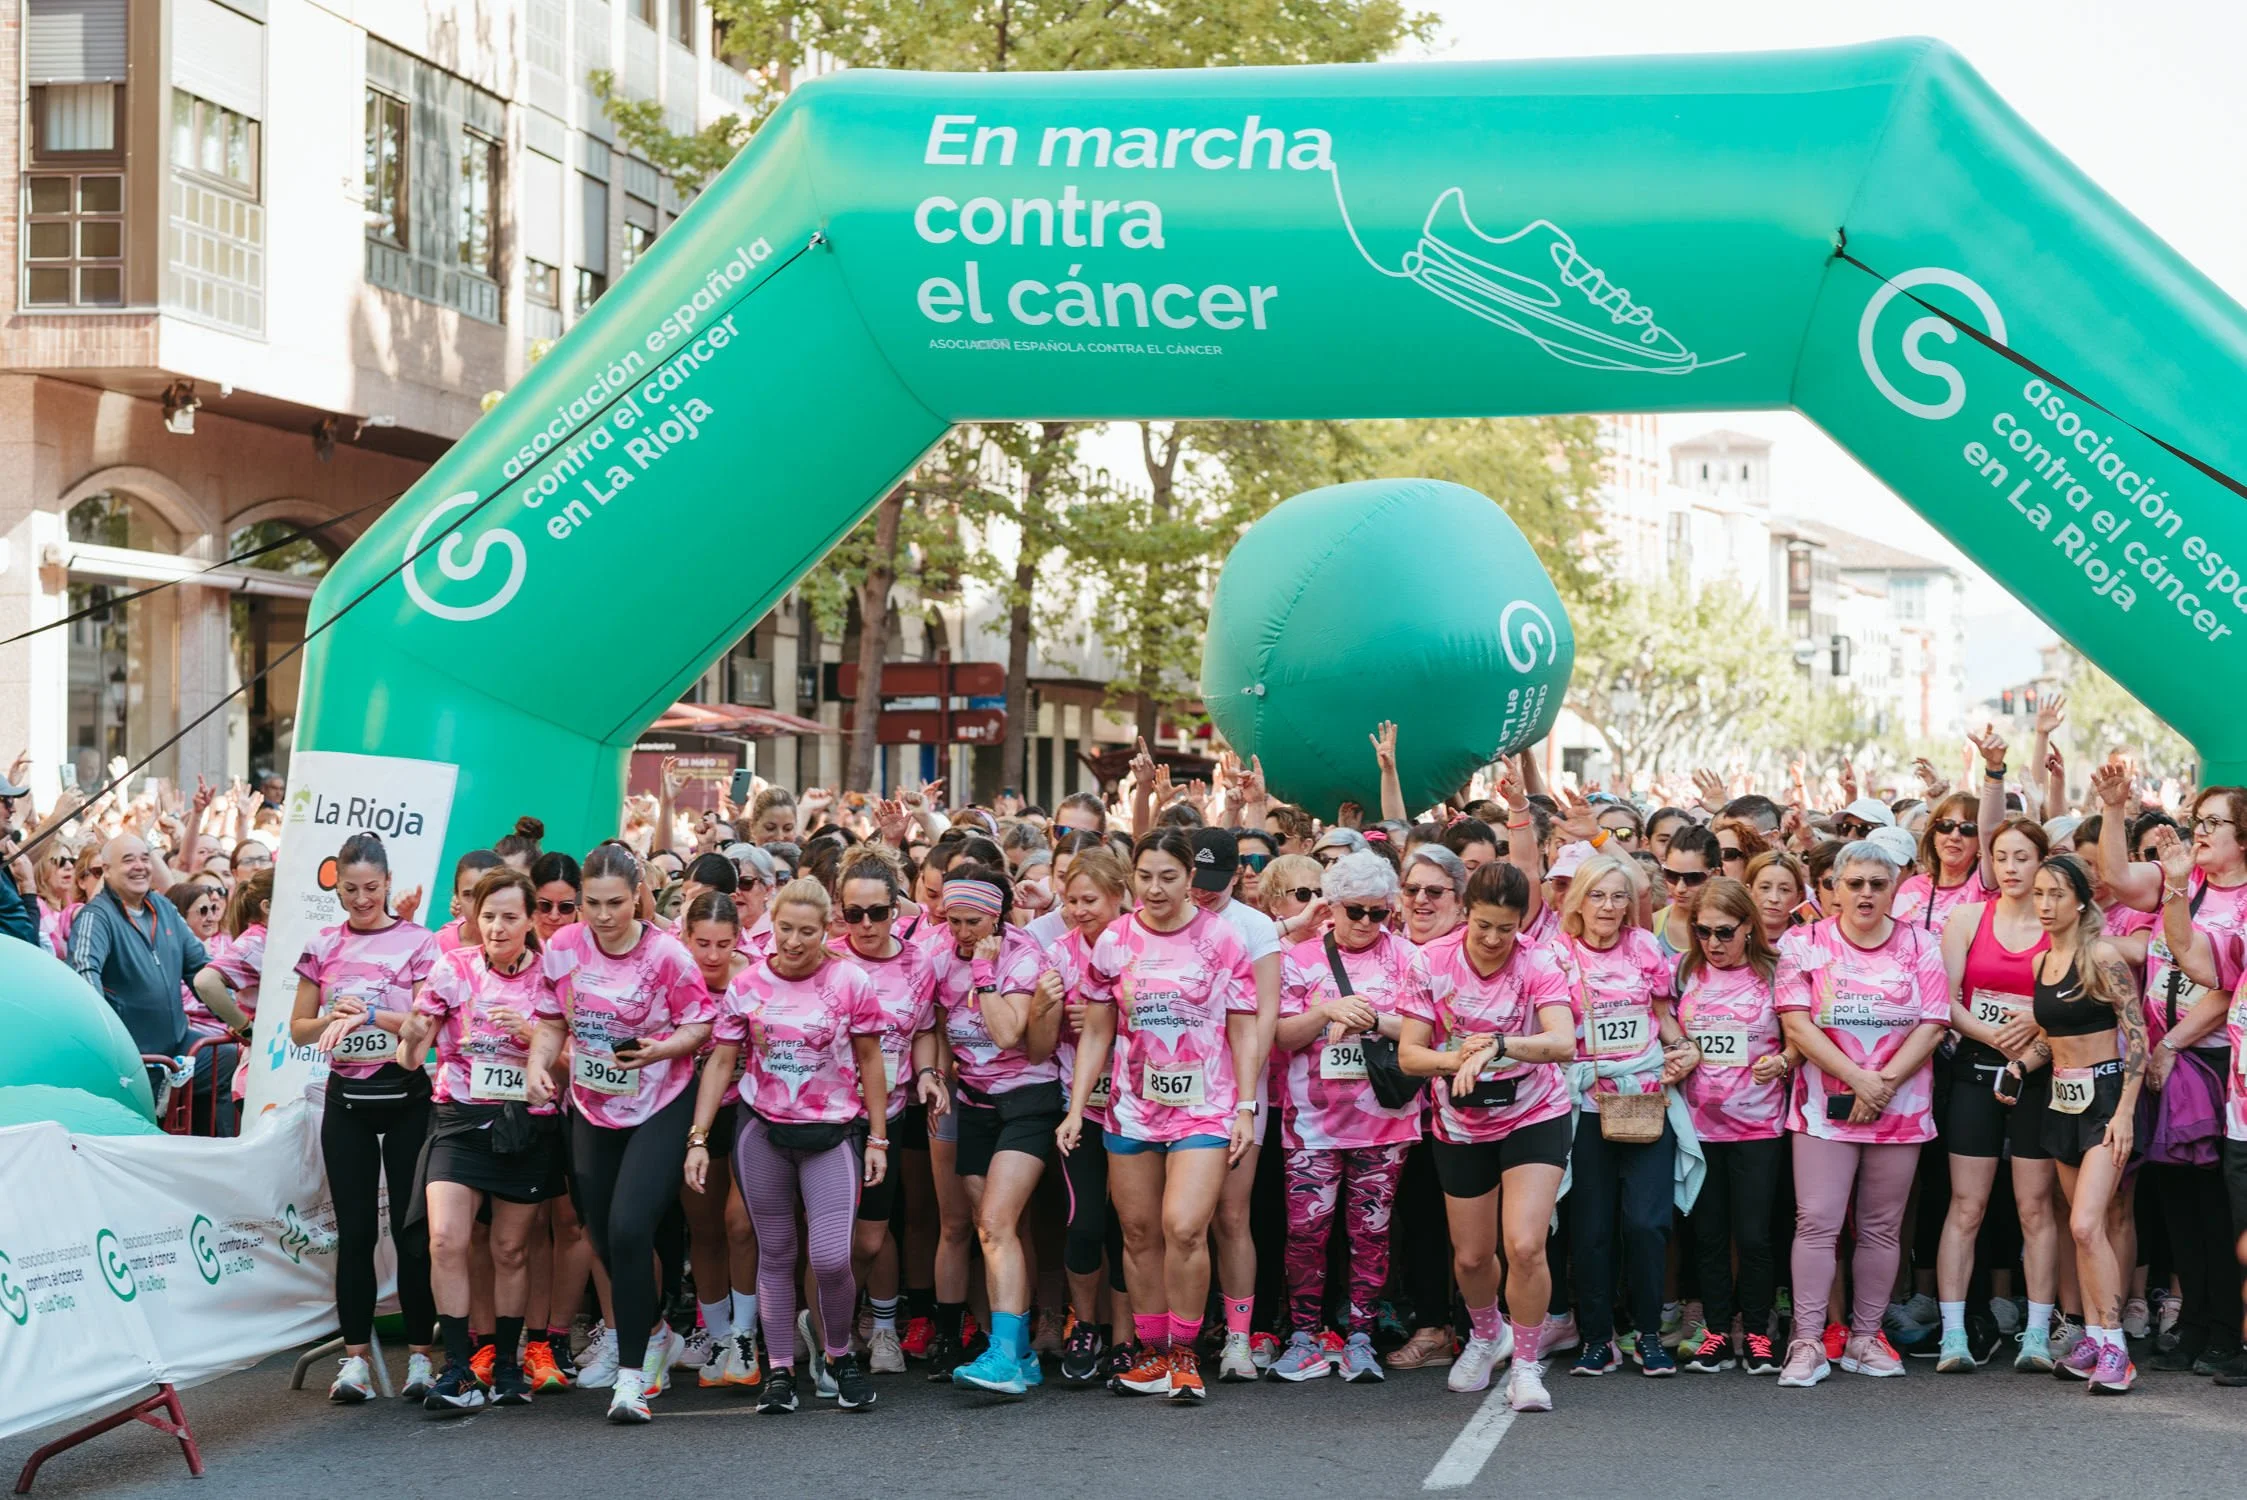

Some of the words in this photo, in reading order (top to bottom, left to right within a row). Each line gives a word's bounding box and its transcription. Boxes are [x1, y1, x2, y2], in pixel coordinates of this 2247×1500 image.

[924, 114, 1018, 166] En
[1038, 115, 1333, 171] marcha
[914, 185, 1165, 249] contra
[917, 260, 994, 325] el
[1008, 264, 1278, 330] cáncer
[928, 338, 1011, 350] ASOCIACIÓN
[1013, 340, 1086, 352] ESPAÑOLA
[1087, 342, 1146, 354] CONTRA
[1147, 344, 1164, 355] EL
[1166, 342, 1224, 356] CÁNCER
[502, 352, 645, 480] asociación
[646, 236, 773, 353] española
[522, 426, 615, 509] contra
[613, 396, 645, 430] el
[644, 314, 740, 405] cáncer
[546, 498, 592, 540] en
[582, 462, 635, 506] La
[624, 397, 714, 470] Rioja
[2023, 378, 2183, 540] asociación
[1963, 440, 2011, 489] en
[2006, 479, 2054, 532] La
[2052, 522, 2139, 613] Rioja
[1992, 412, 2094, 513] contra
[2091, 508, 2132, 543] el
[2124, 540, 2233, 642] cáncer
[1505, 688, 1520, 714] en
[1499, 718, 1518, 742] La
[314, 793, 341, 825] La
[346, 796, 424, 839] Rioja
[1135, 978, 1147, 989] XI
[1836, 978, 1848, 988] XI
[1134, 990, 1180, 1001] Carrera
[1324, 989, 1335, 999] XI
[1834, 990, 1882, 1001] Carrera
[573, 1004, 616, 1021] Carrera
[1136, 1004, 1154, 1017] por
[1155, 1002, 1168, 1013] la
[1592, 999, 1631, 1010] Carrera
[1833, 1004, 1854, 1016] por
[1857, 1003, 1869, 1014] la
[1978, 1002, 2009, 1025] 392
[591, 1020, 604, 1031] la
[1597, 1020, 1637, 1041] 1237
[1833, 1015, 1914, 1029] Investigación
[341, 1033, 388, 1054] 3963
[1695, 1035, 1735, 1054] 1252
[289, 1044, 327, 1064] viam
[783, 1050, 794, 1061] la
[1330, 1047, 1364, 1066] 394
[484, 1067, 524, 1089] 7134
[583, 1060, 628, 1085] 3962
[2094, 1061, 2118, 1079] KE
[1092, 1076, 1112, 1095] 28
[1151, 1073, 1193, 1094] 8567
